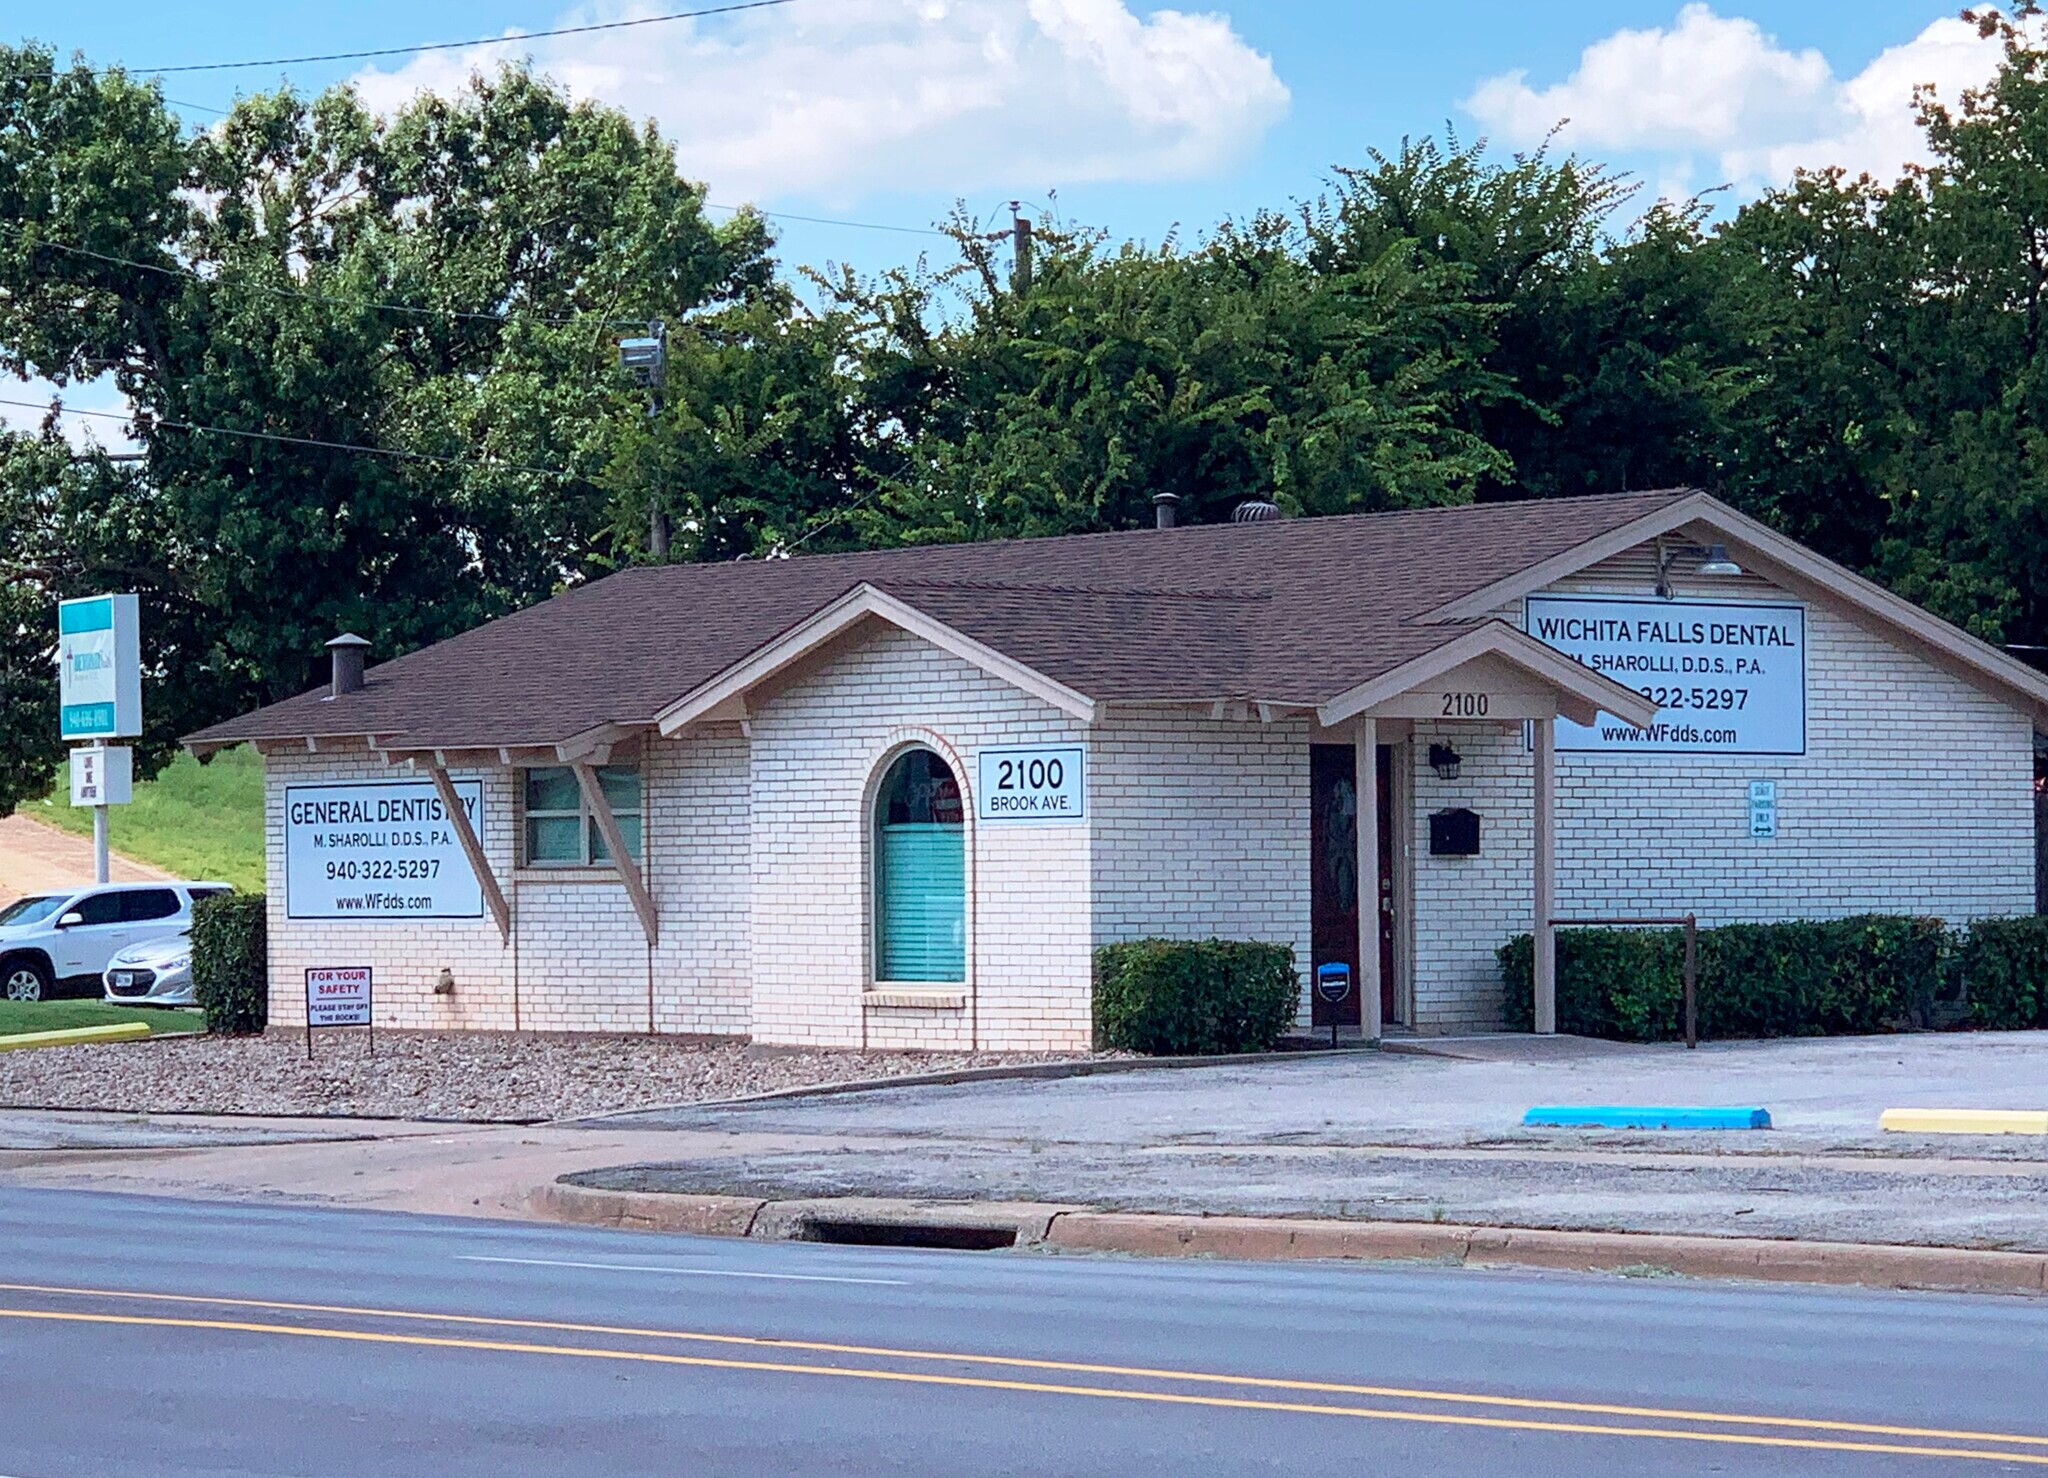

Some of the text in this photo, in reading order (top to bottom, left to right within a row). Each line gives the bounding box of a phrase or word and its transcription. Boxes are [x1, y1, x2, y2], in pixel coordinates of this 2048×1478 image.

[1537, 618, 1795, 647] WICHITA FALLS DENTAL
[1591, 654, 1679, 674] SHAROLLI,
[1736, 657, 1766, 674] P.A.
[1442, 692, 1488, 716] 2100
[1601, 724, 1737, 743] www.WFdds.com
[997, 758, 1064, 790] 2100
[290, 796, 476, 825] GENERAL DENTISY
[990, 795, 1072, 811] BROOK AVE.
[313, 833, 327, 848] M.
[431, 831, 453, 846] P.A.
[326, 859, 440, 880] 940-322-5297
[336, 893, 432, 910] www.WFdds.com
[311, 971, 366, 981] FOR YOUR
[318, 984, 360, 994] SAFETY
[310, 1004, 336, 1012] PLEASE
